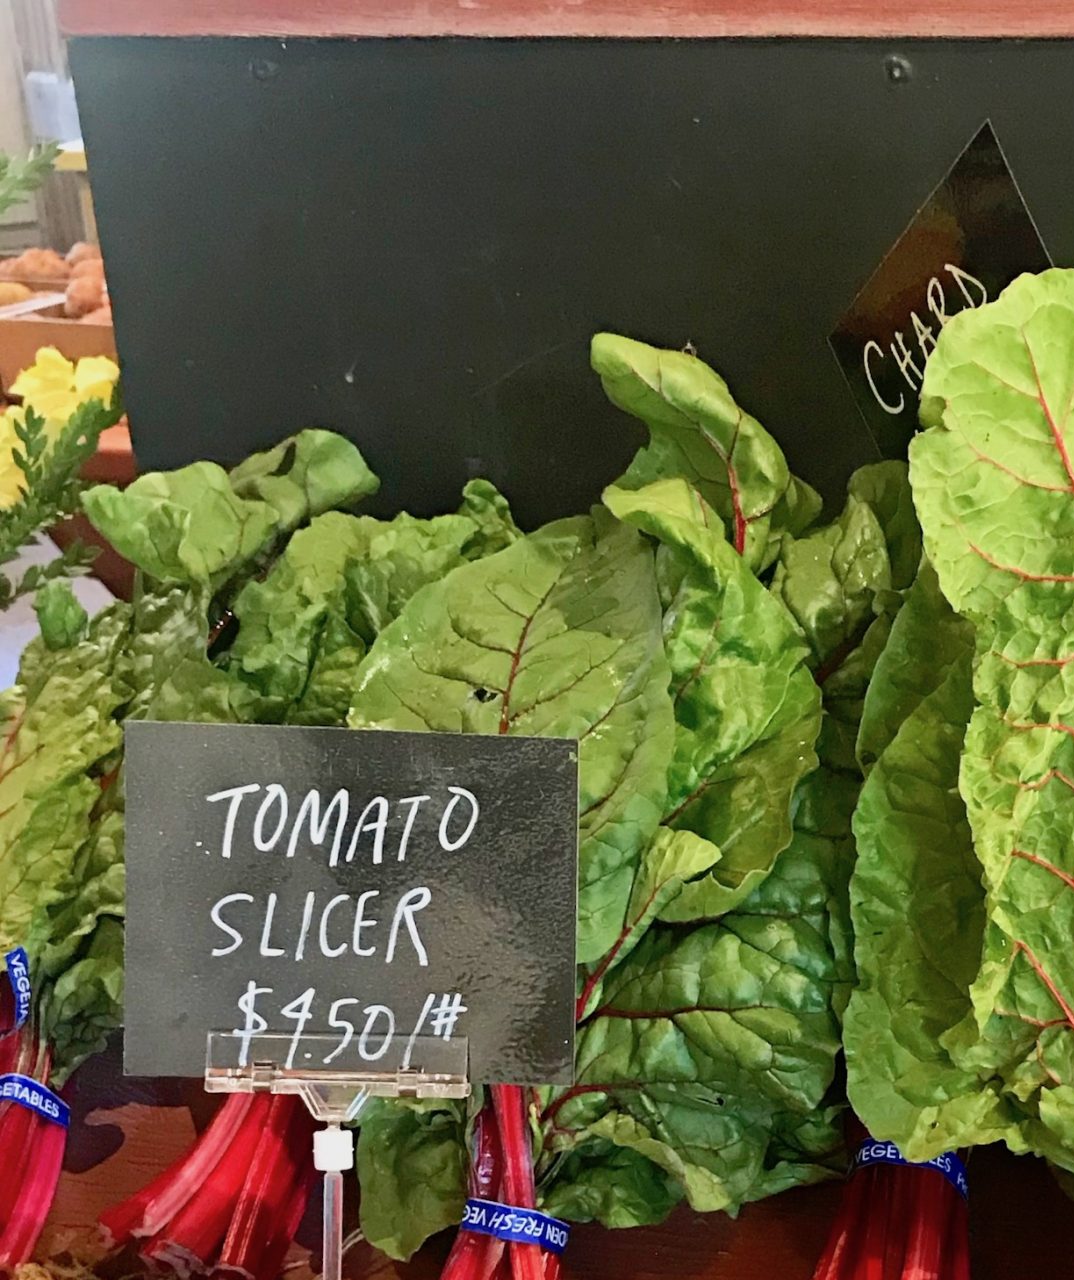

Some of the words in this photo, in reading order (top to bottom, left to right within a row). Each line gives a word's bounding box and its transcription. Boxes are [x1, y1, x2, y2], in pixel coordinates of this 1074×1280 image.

[206, 782, 480, 868] TOMATO
[209, 885, 433, 967] SLICER
[488, 1211, 545, 1238] FRESH
